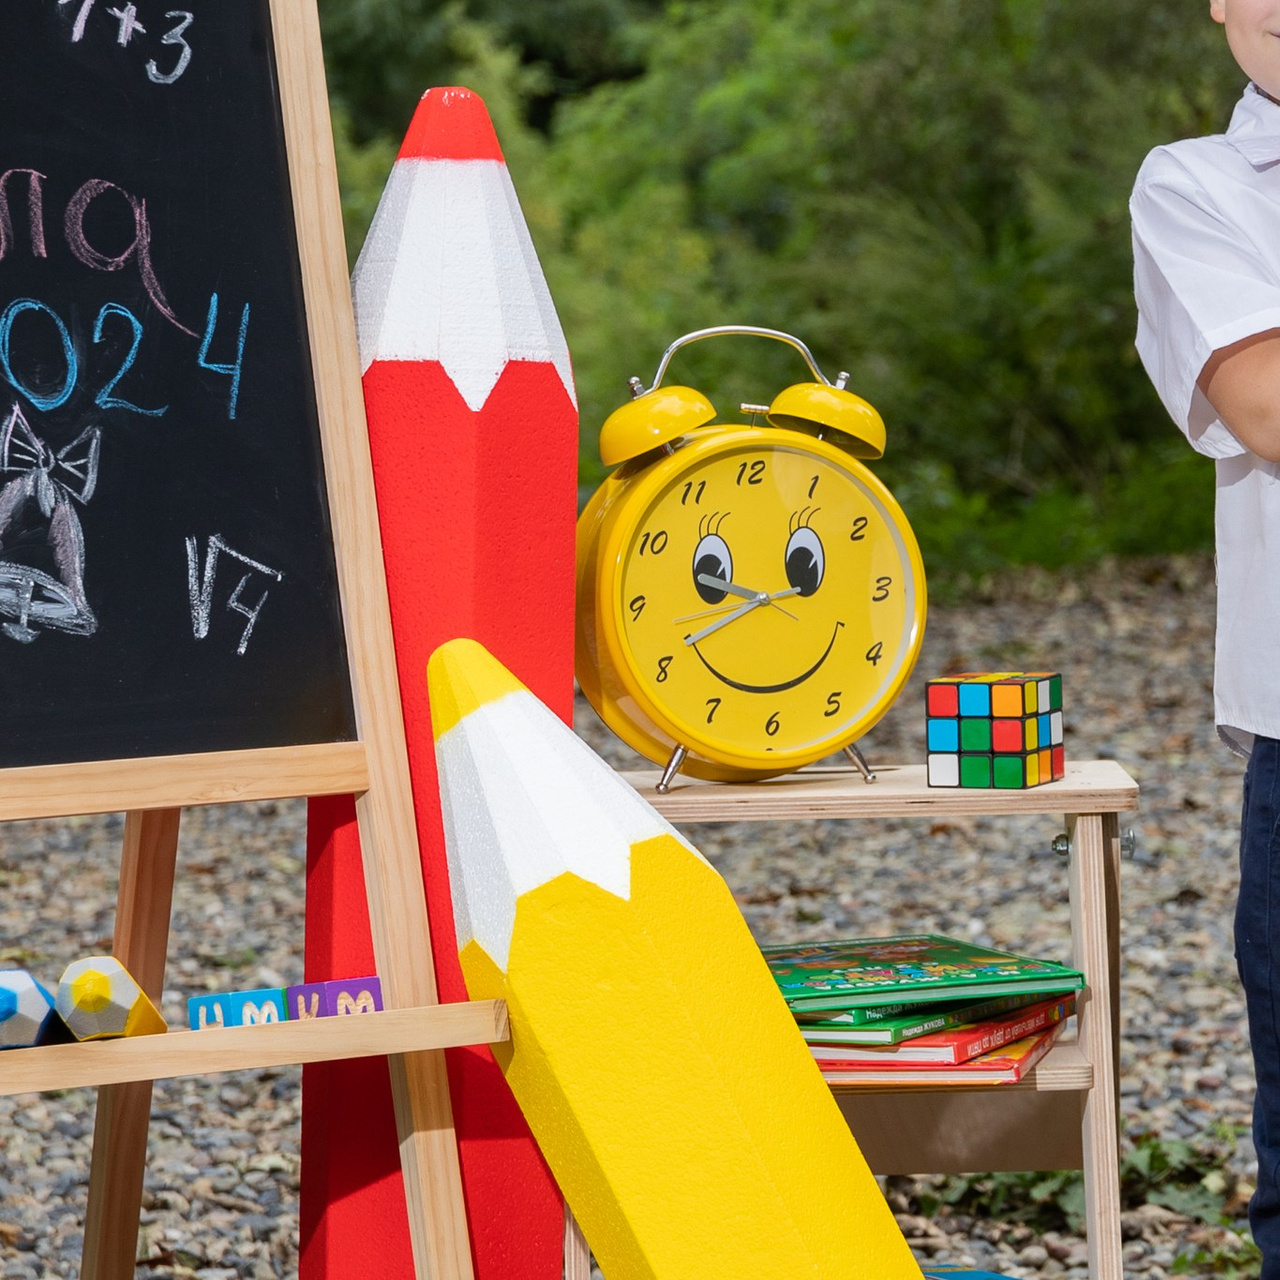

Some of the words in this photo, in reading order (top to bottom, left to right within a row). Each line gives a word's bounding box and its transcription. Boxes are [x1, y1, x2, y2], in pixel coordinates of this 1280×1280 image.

[736, 460, 766, 486] 12
[681, 480, 706, 505] 11
[808, 475, 820, 499] 1
[850, 516, 868, 541] 2
[639, 530, 668, 556] 10
[872, 576, 892, 602] 3
[629, 595, 646, 622] 9
[865, 641, 883, 666] 4
[656, 656, 674, 683] 8
[705, 698, 722, 724] 7
[824, 692, 842, 717] 5
[765, 711, 780, 736] 6
